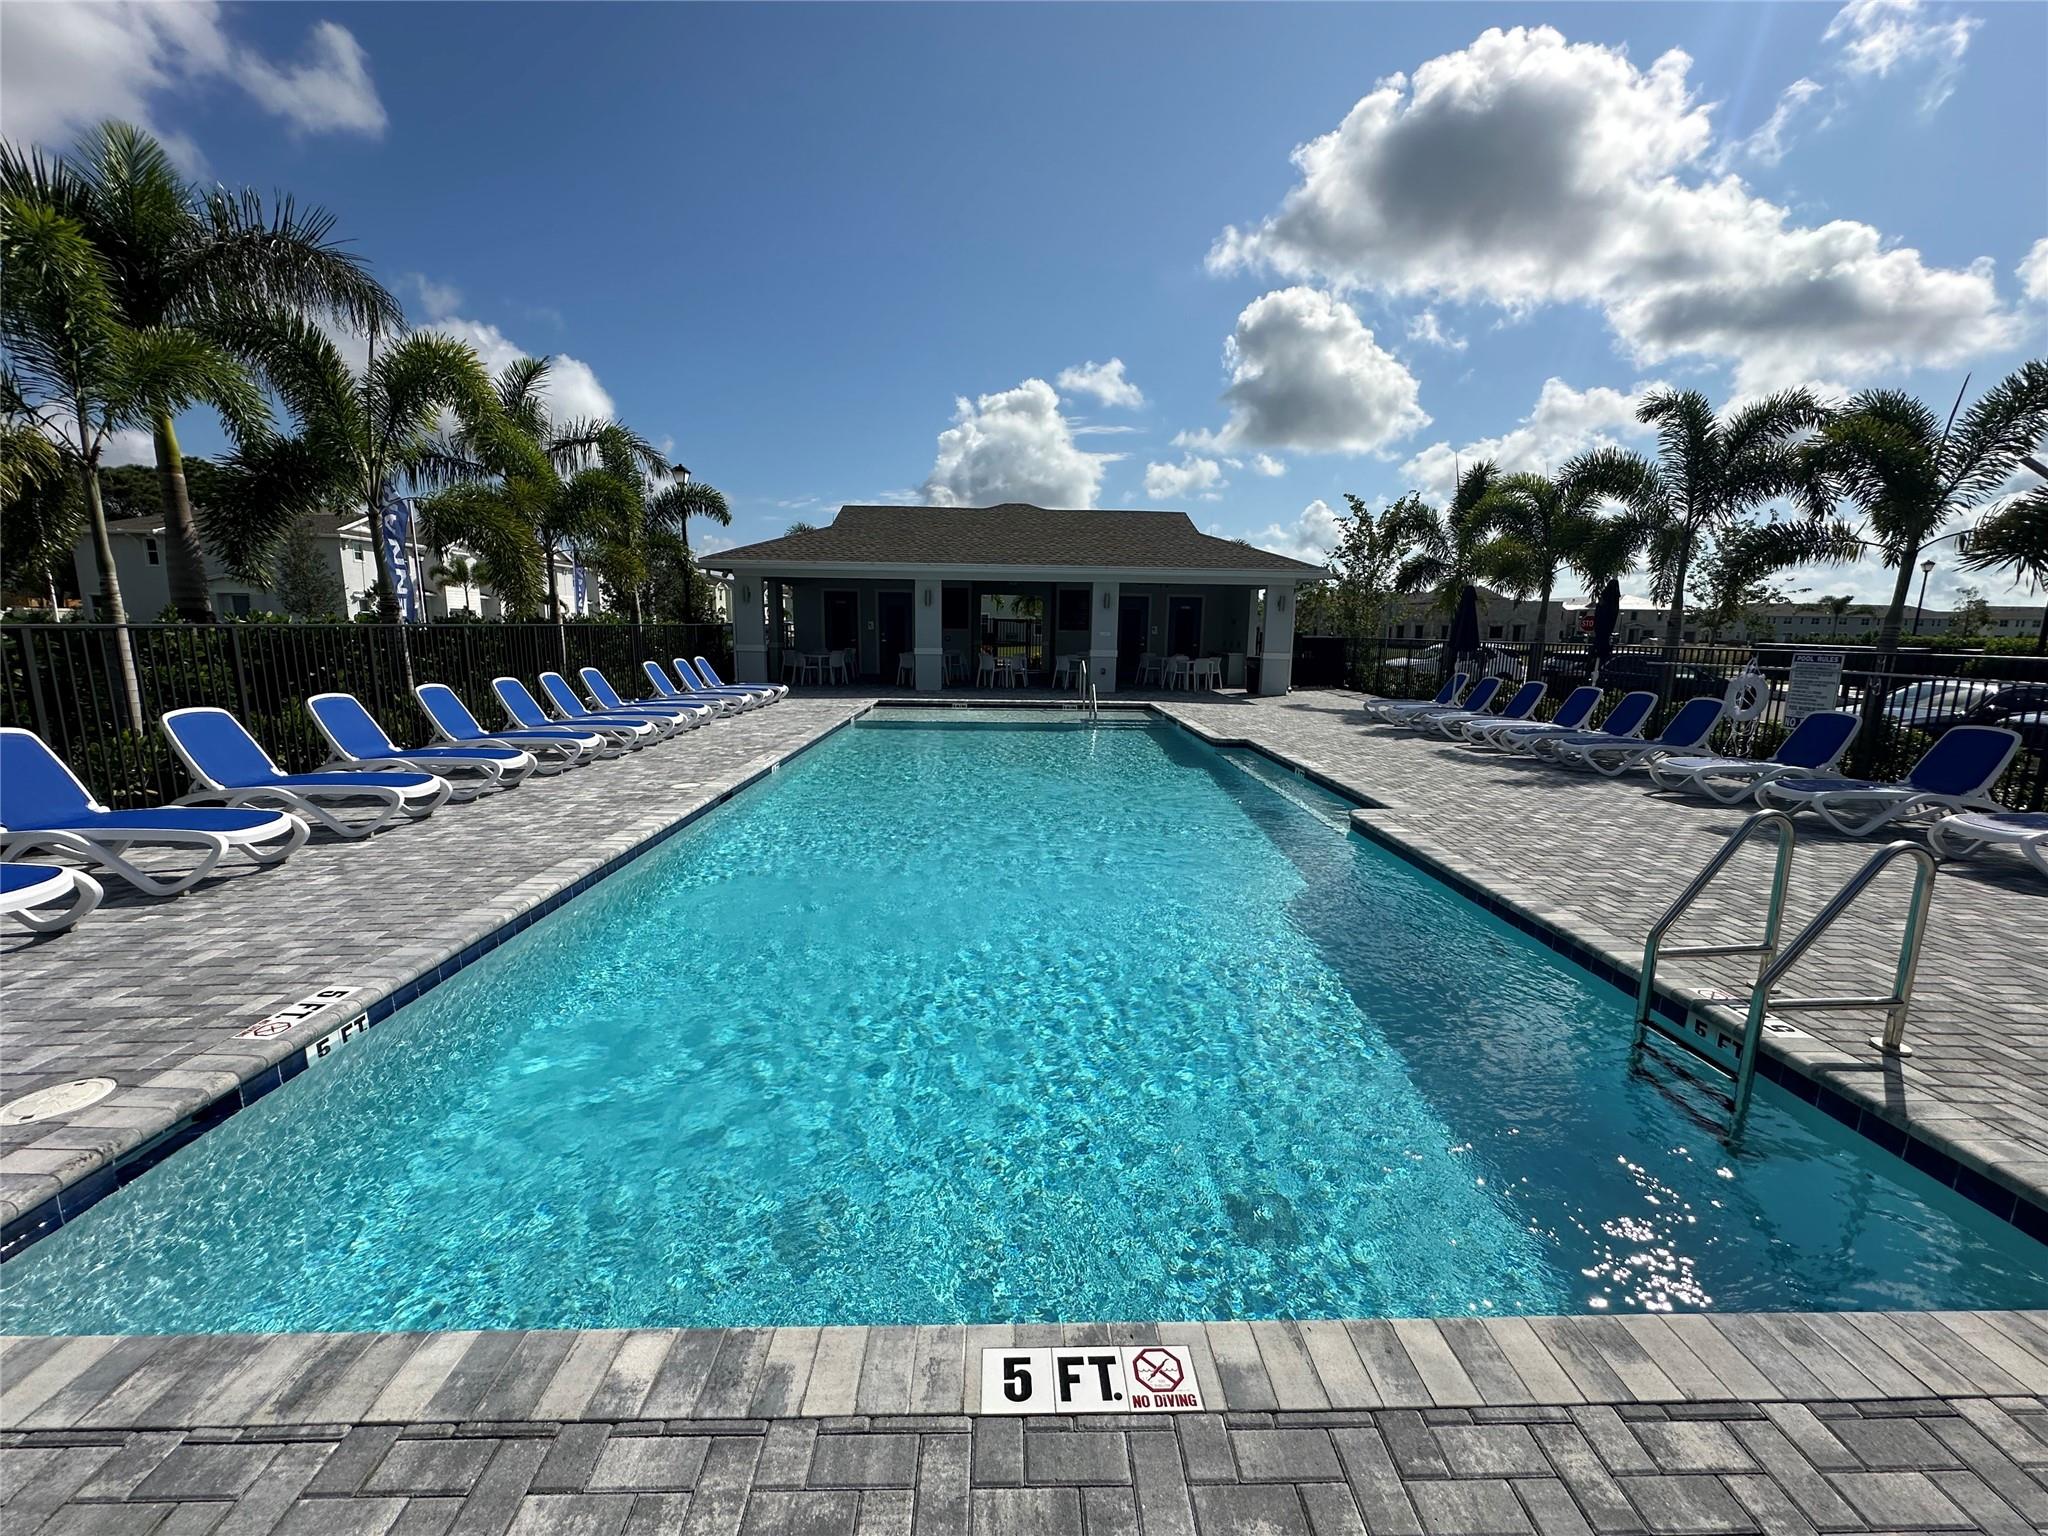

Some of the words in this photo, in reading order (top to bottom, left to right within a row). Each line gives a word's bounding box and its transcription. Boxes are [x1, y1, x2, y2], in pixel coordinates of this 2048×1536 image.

[317, 990, 349, 998] 5
[1694, 1018, 1708, 1038] 5
[316, 1038, 331, 1058] 5
[1003, 1356, 1033, 1403] 5
[1057, 1355, 1123, 1402] FT.
[1132, 1394, 1151, 1409] NO
